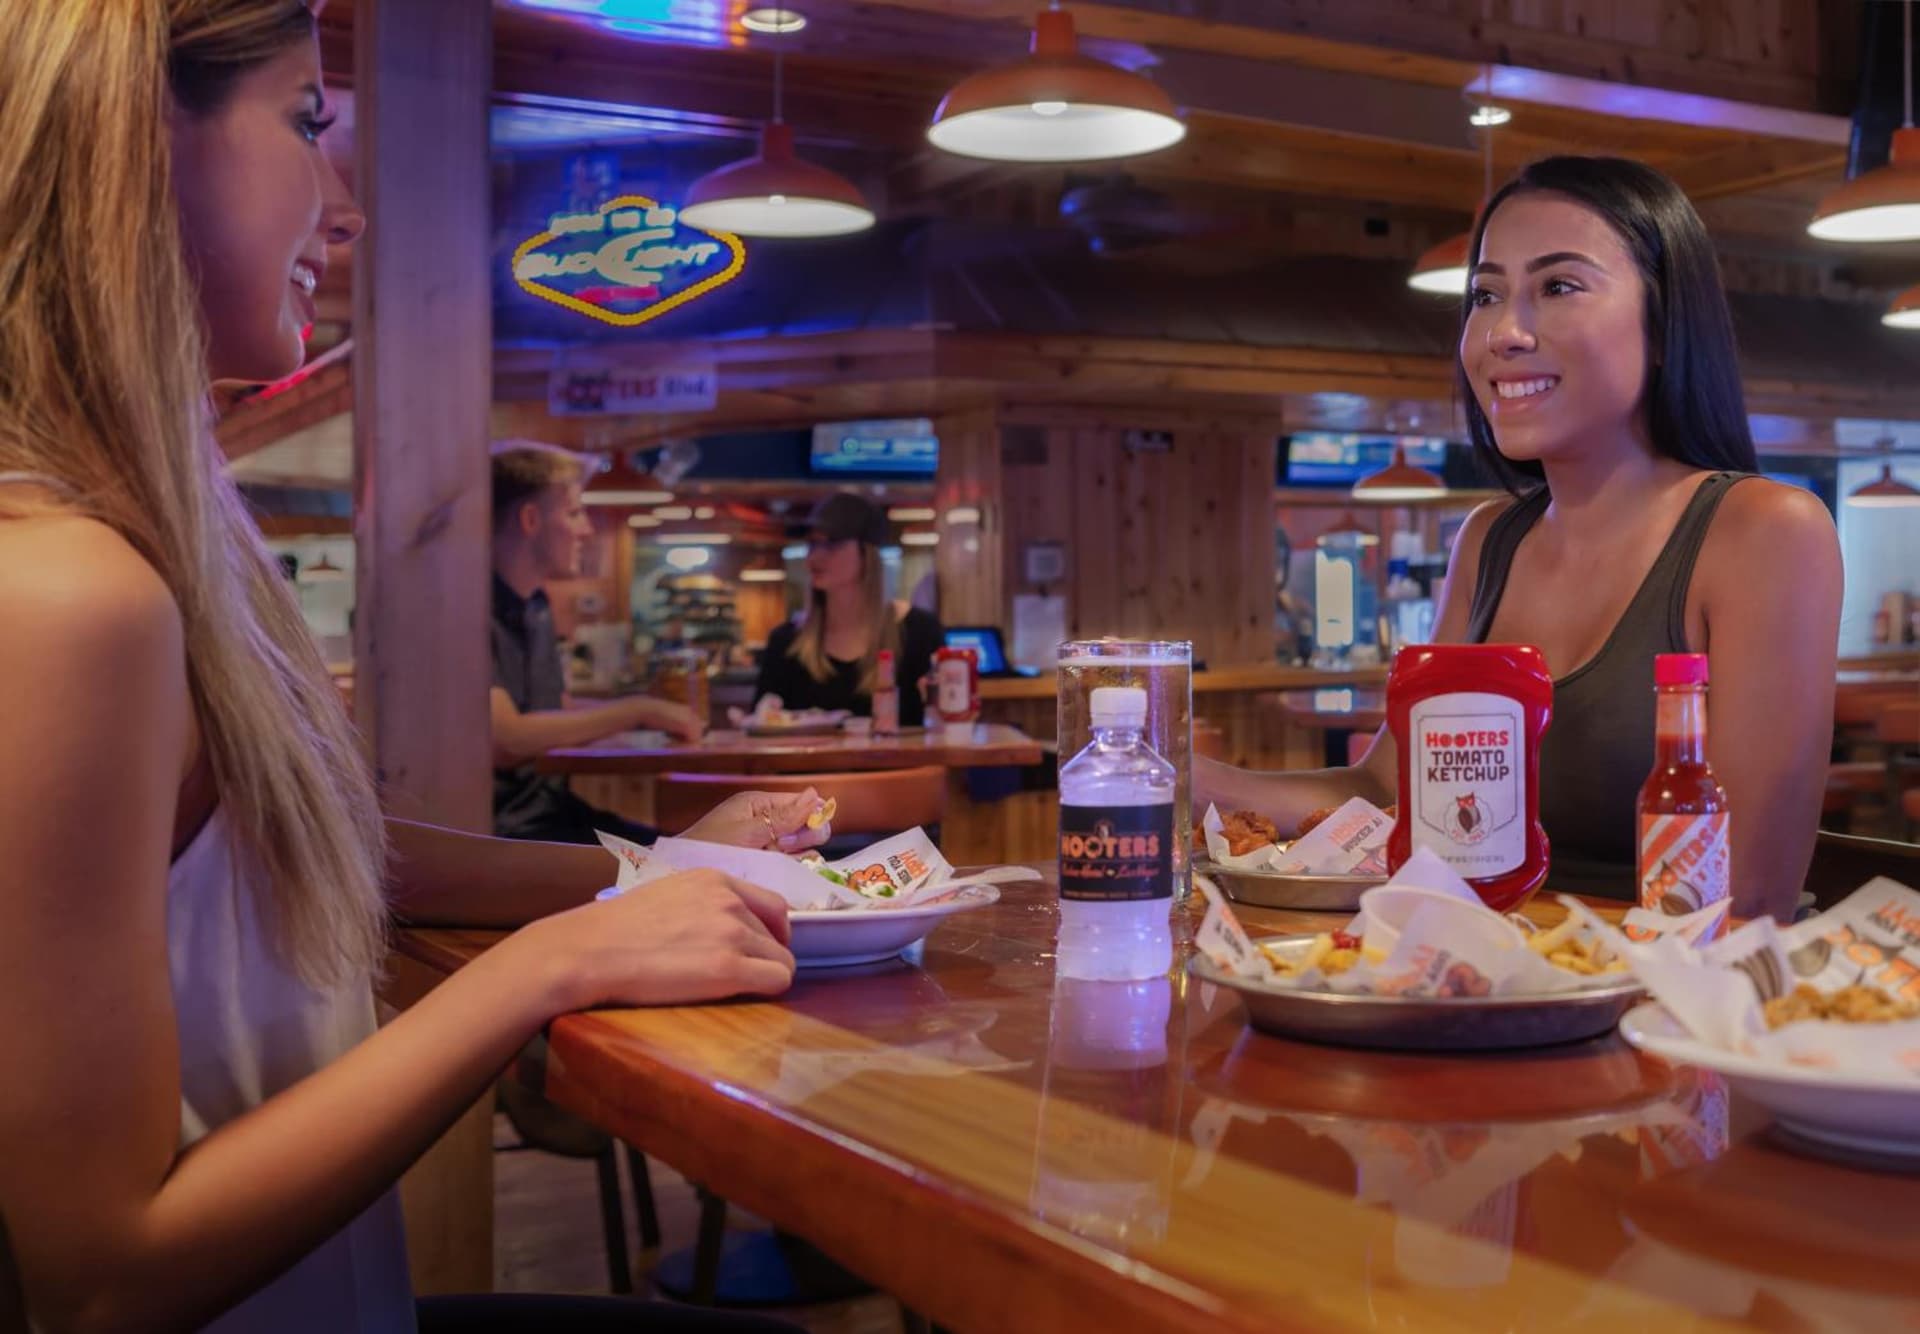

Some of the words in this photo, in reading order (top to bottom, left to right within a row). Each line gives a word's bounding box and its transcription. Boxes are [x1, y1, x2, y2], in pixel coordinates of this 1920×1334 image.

[1425, 731, 1509, 748] HOOTERS
[1431, 750, 1505, 766] TOMATO
[1427, 766, 1510, 783] KETCHUP
